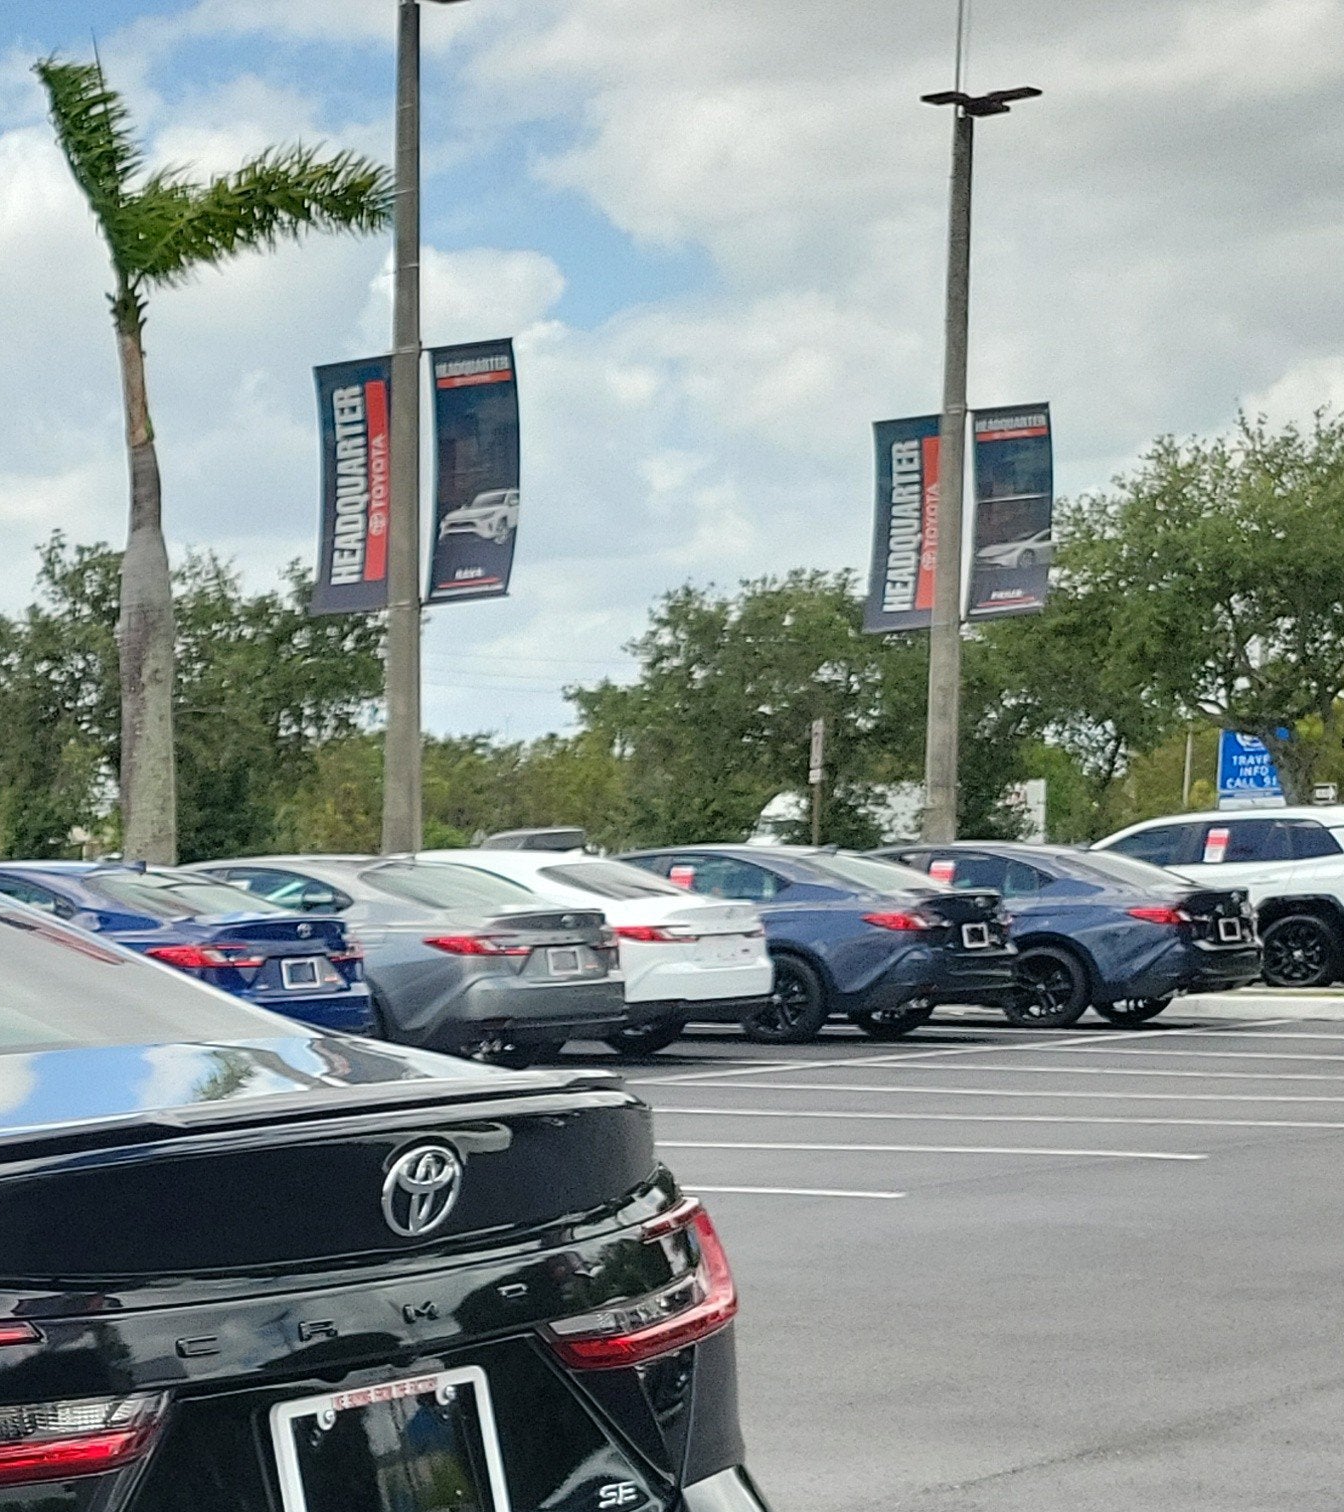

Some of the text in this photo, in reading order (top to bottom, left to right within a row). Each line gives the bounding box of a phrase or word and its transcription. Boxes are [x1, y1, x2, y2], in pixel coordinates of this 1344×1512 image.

[330, 384, 371, 585] HEADQUARTER
[371, 433, 391, 508] TOYOTA
[882, 439, 923, 612] HEADQUARTER
[1239, 765, 1269, 776] INFO
[598, 1480, 638, 1509] SE
